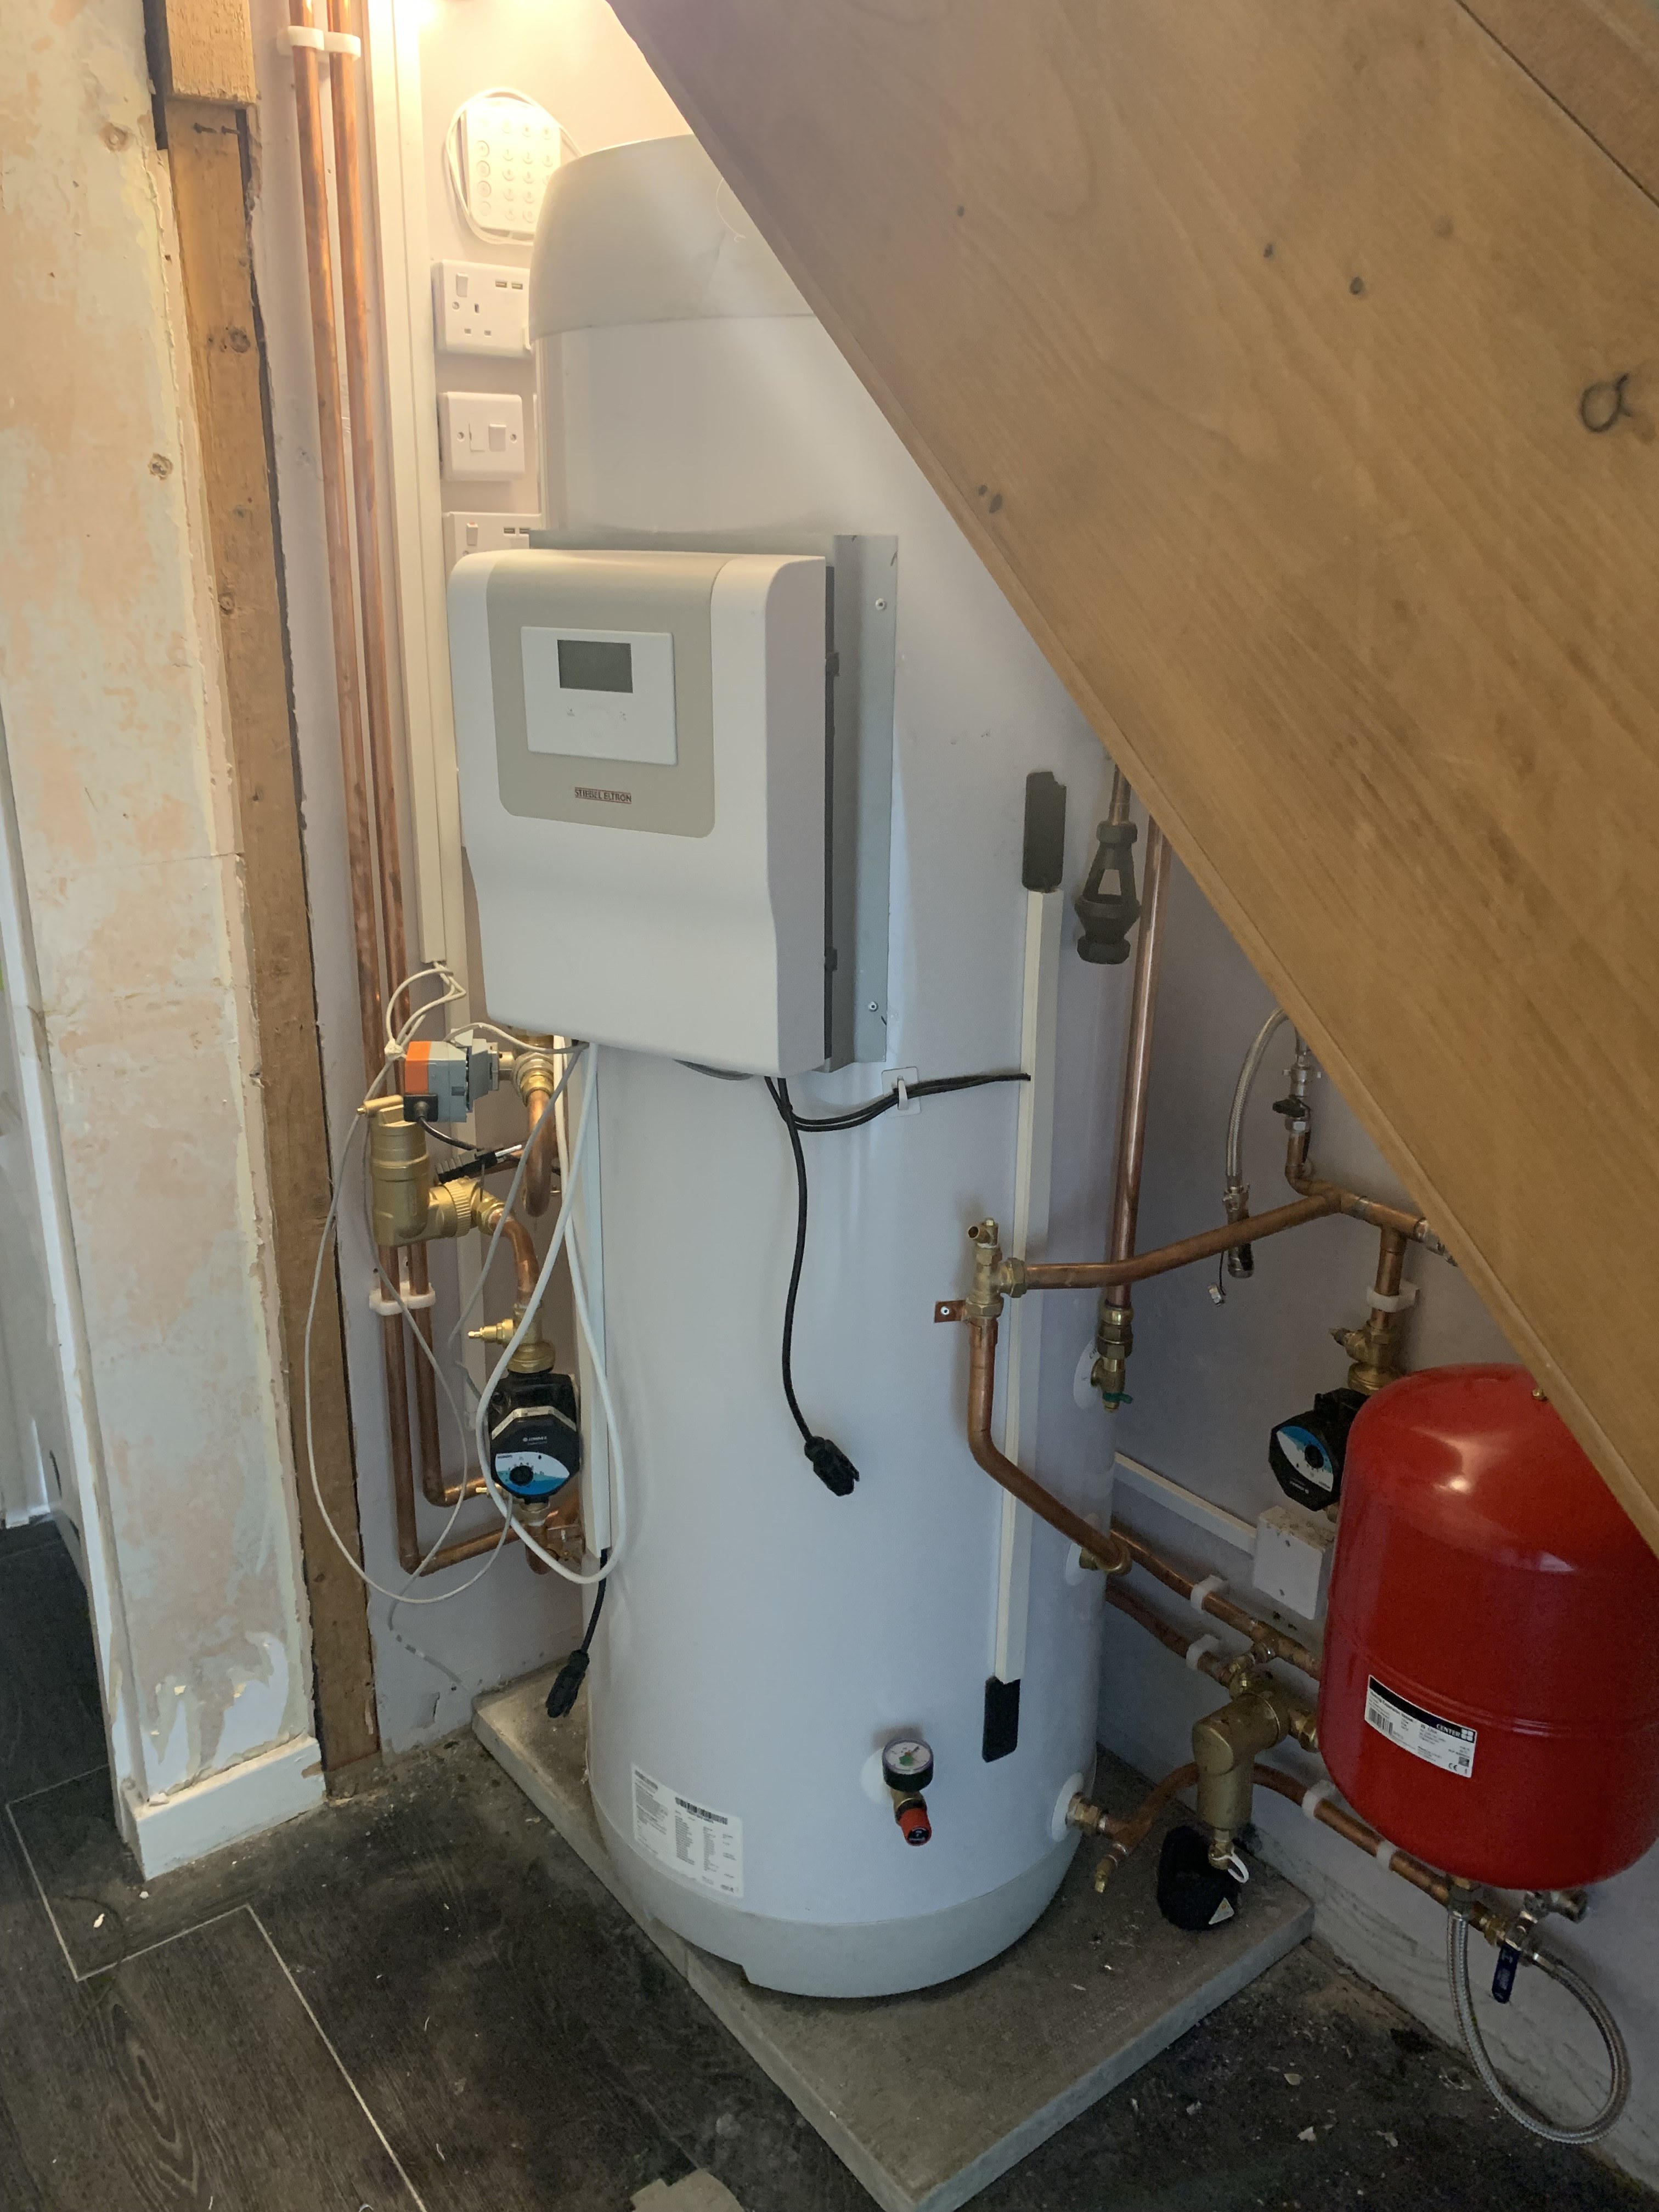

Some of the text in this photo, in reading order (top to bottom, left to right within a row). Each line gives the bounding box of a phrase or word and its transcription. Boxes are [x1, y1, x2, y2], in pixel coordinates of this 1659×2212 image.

[575, 789, 632, 803] STIEBEL ELTRON
[1436, 1724, 1460, 1737] CENTER
